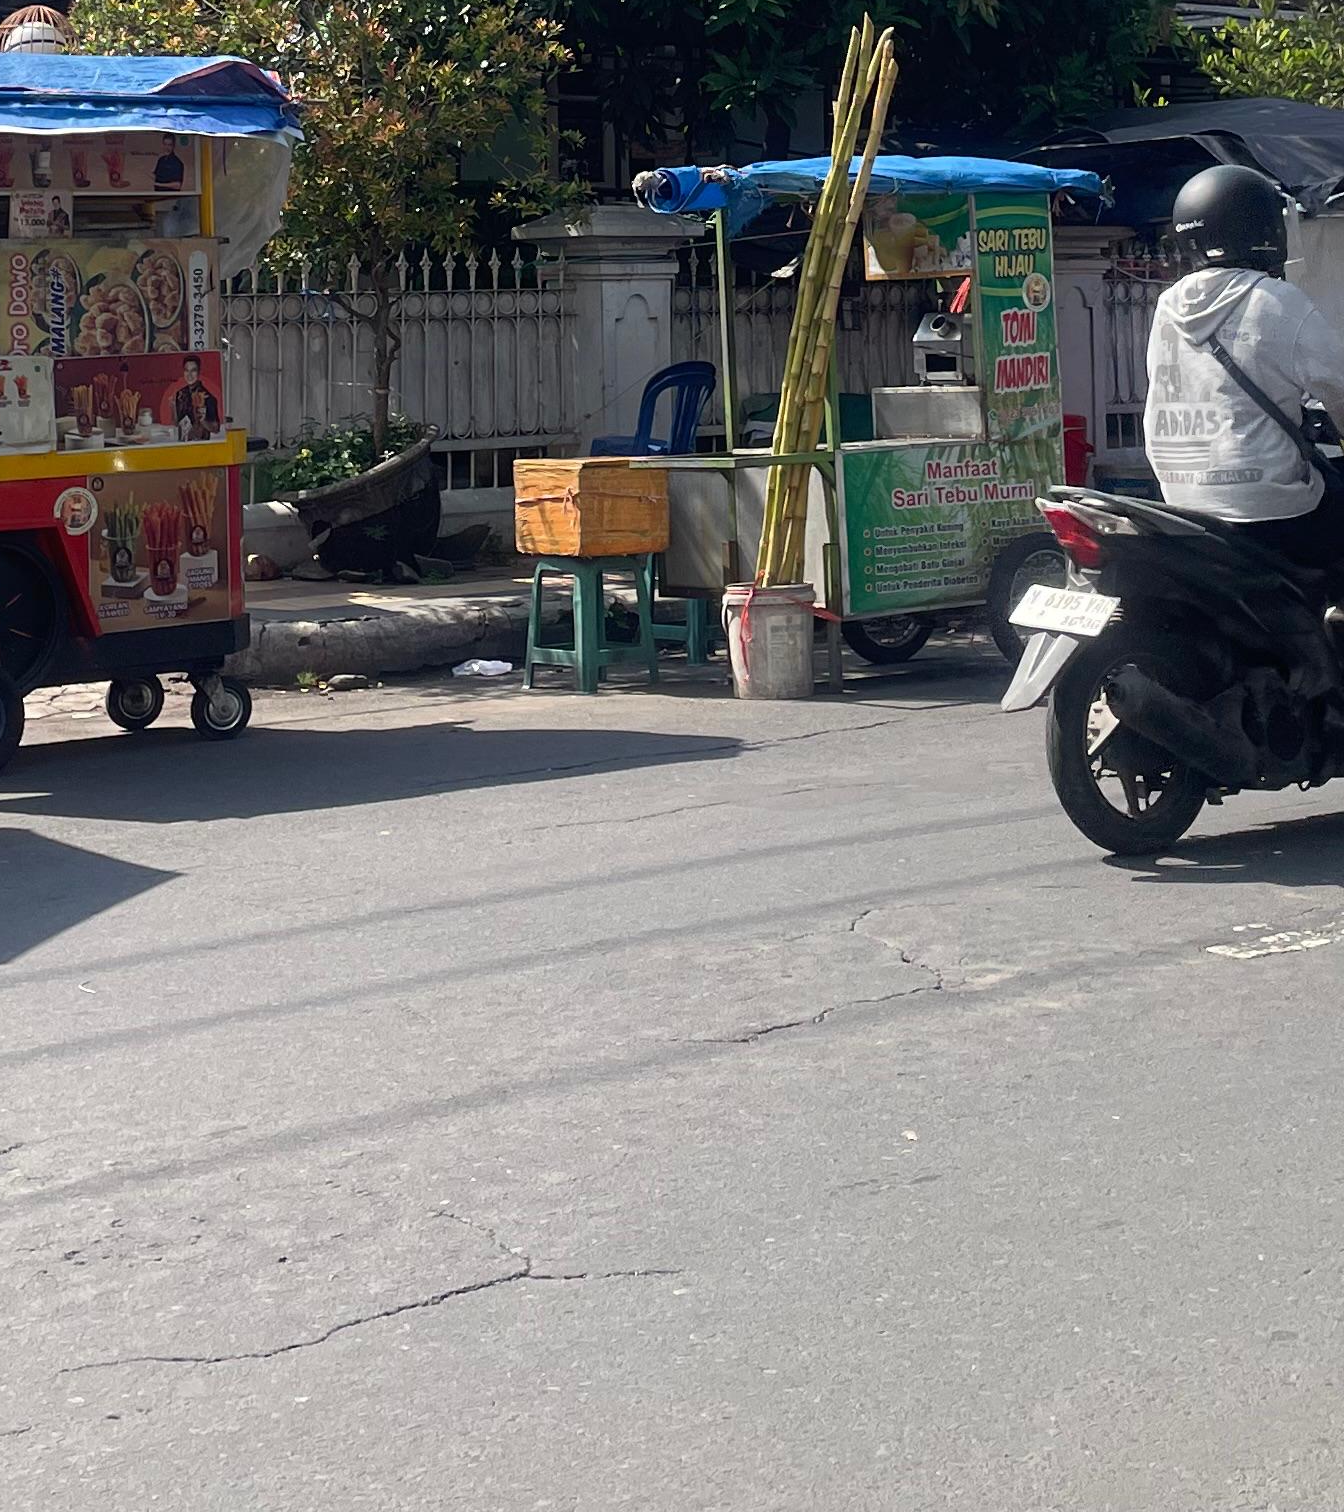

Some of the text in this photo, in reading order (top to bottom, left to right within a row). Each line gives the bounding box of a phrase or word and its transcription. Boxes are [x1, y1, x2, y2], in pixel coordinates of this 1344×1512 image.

[978, 228, 1047, 253] SARI TEBU
[995, 254, 1035, 278] HIJAU
[193, 268, 205, 351] 3-3279-3450
[1002, 311, 1037, 344] TOMI
[996, 355, 1049, 390] MANDIRI
[926, 459, 999, 479] Manfaat
[892, 481, 1034, 508] Sari Tebu Murni
